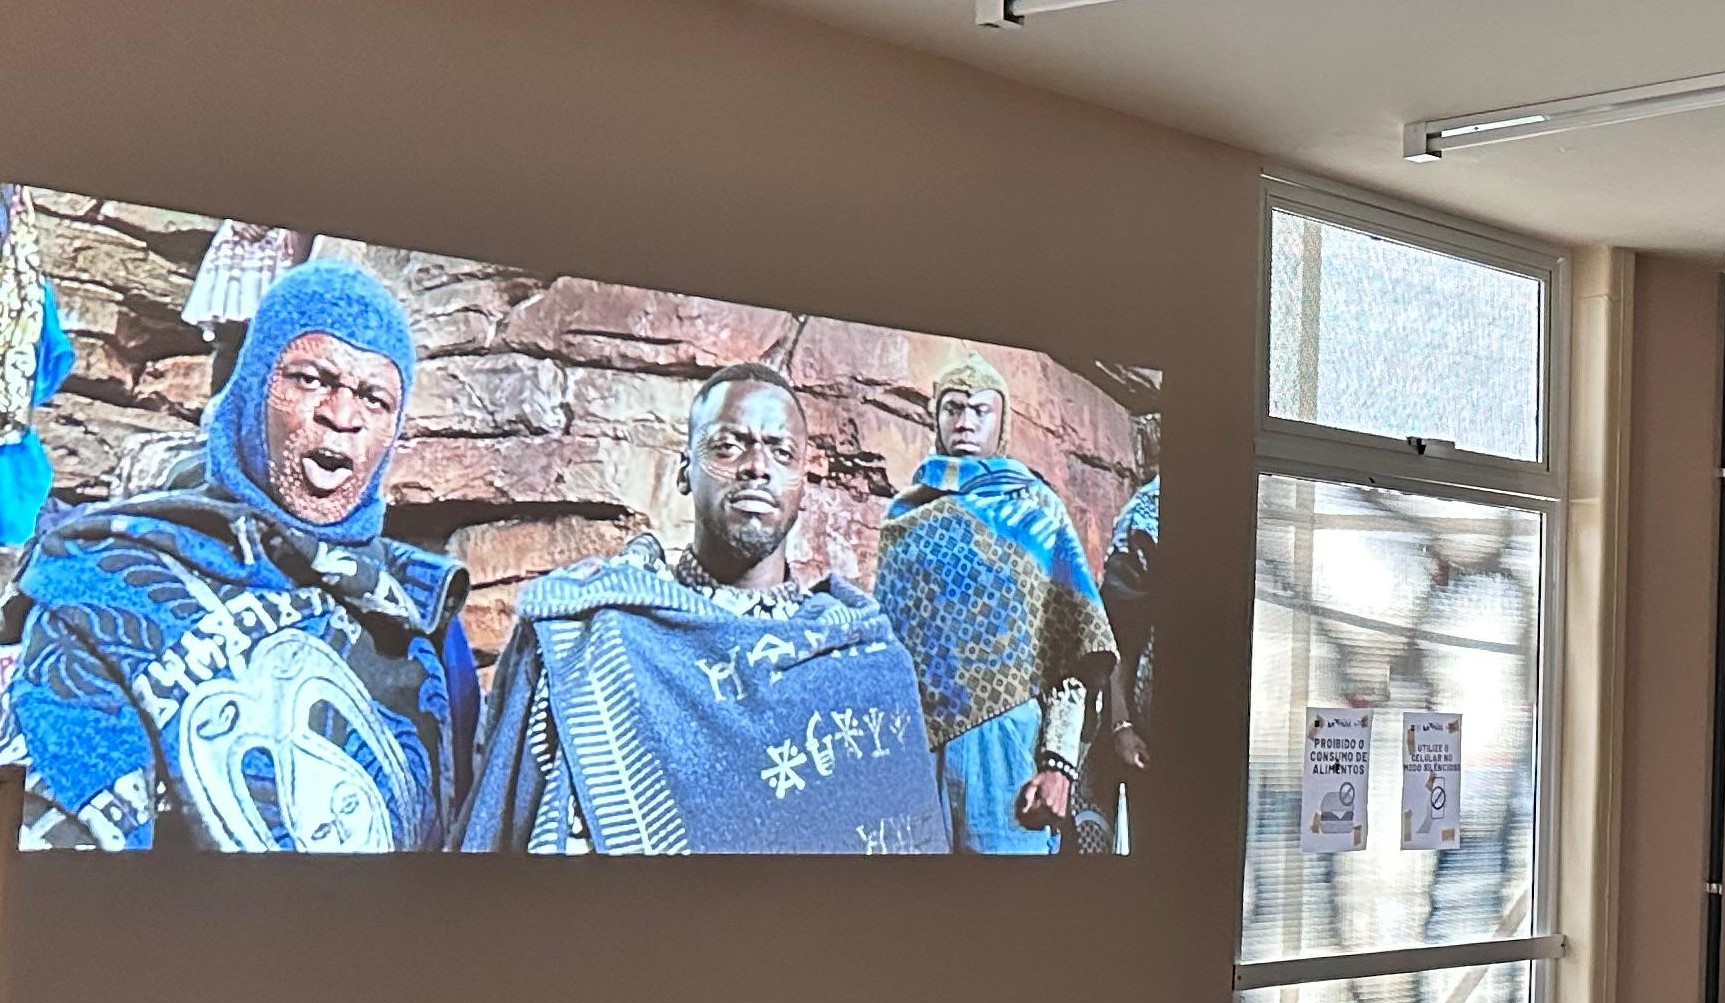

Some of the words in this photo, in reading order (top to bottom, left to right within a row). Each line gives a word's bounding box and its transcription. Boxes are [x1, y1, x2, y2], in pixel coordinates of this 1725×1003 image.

[1314, 738, 1356, 749] PROIBIDO
[1358, 739, 1365, 750] O
[1417, 744, 1442, 752] UTILIZE
[1310, 751, 1354, 763] CONSUMO
[1355, 752, 1368, 763] DE
[1411, 754, 1442, 762] CELULAR
[1312, 764, 1365, 775] ALIMENTOS
